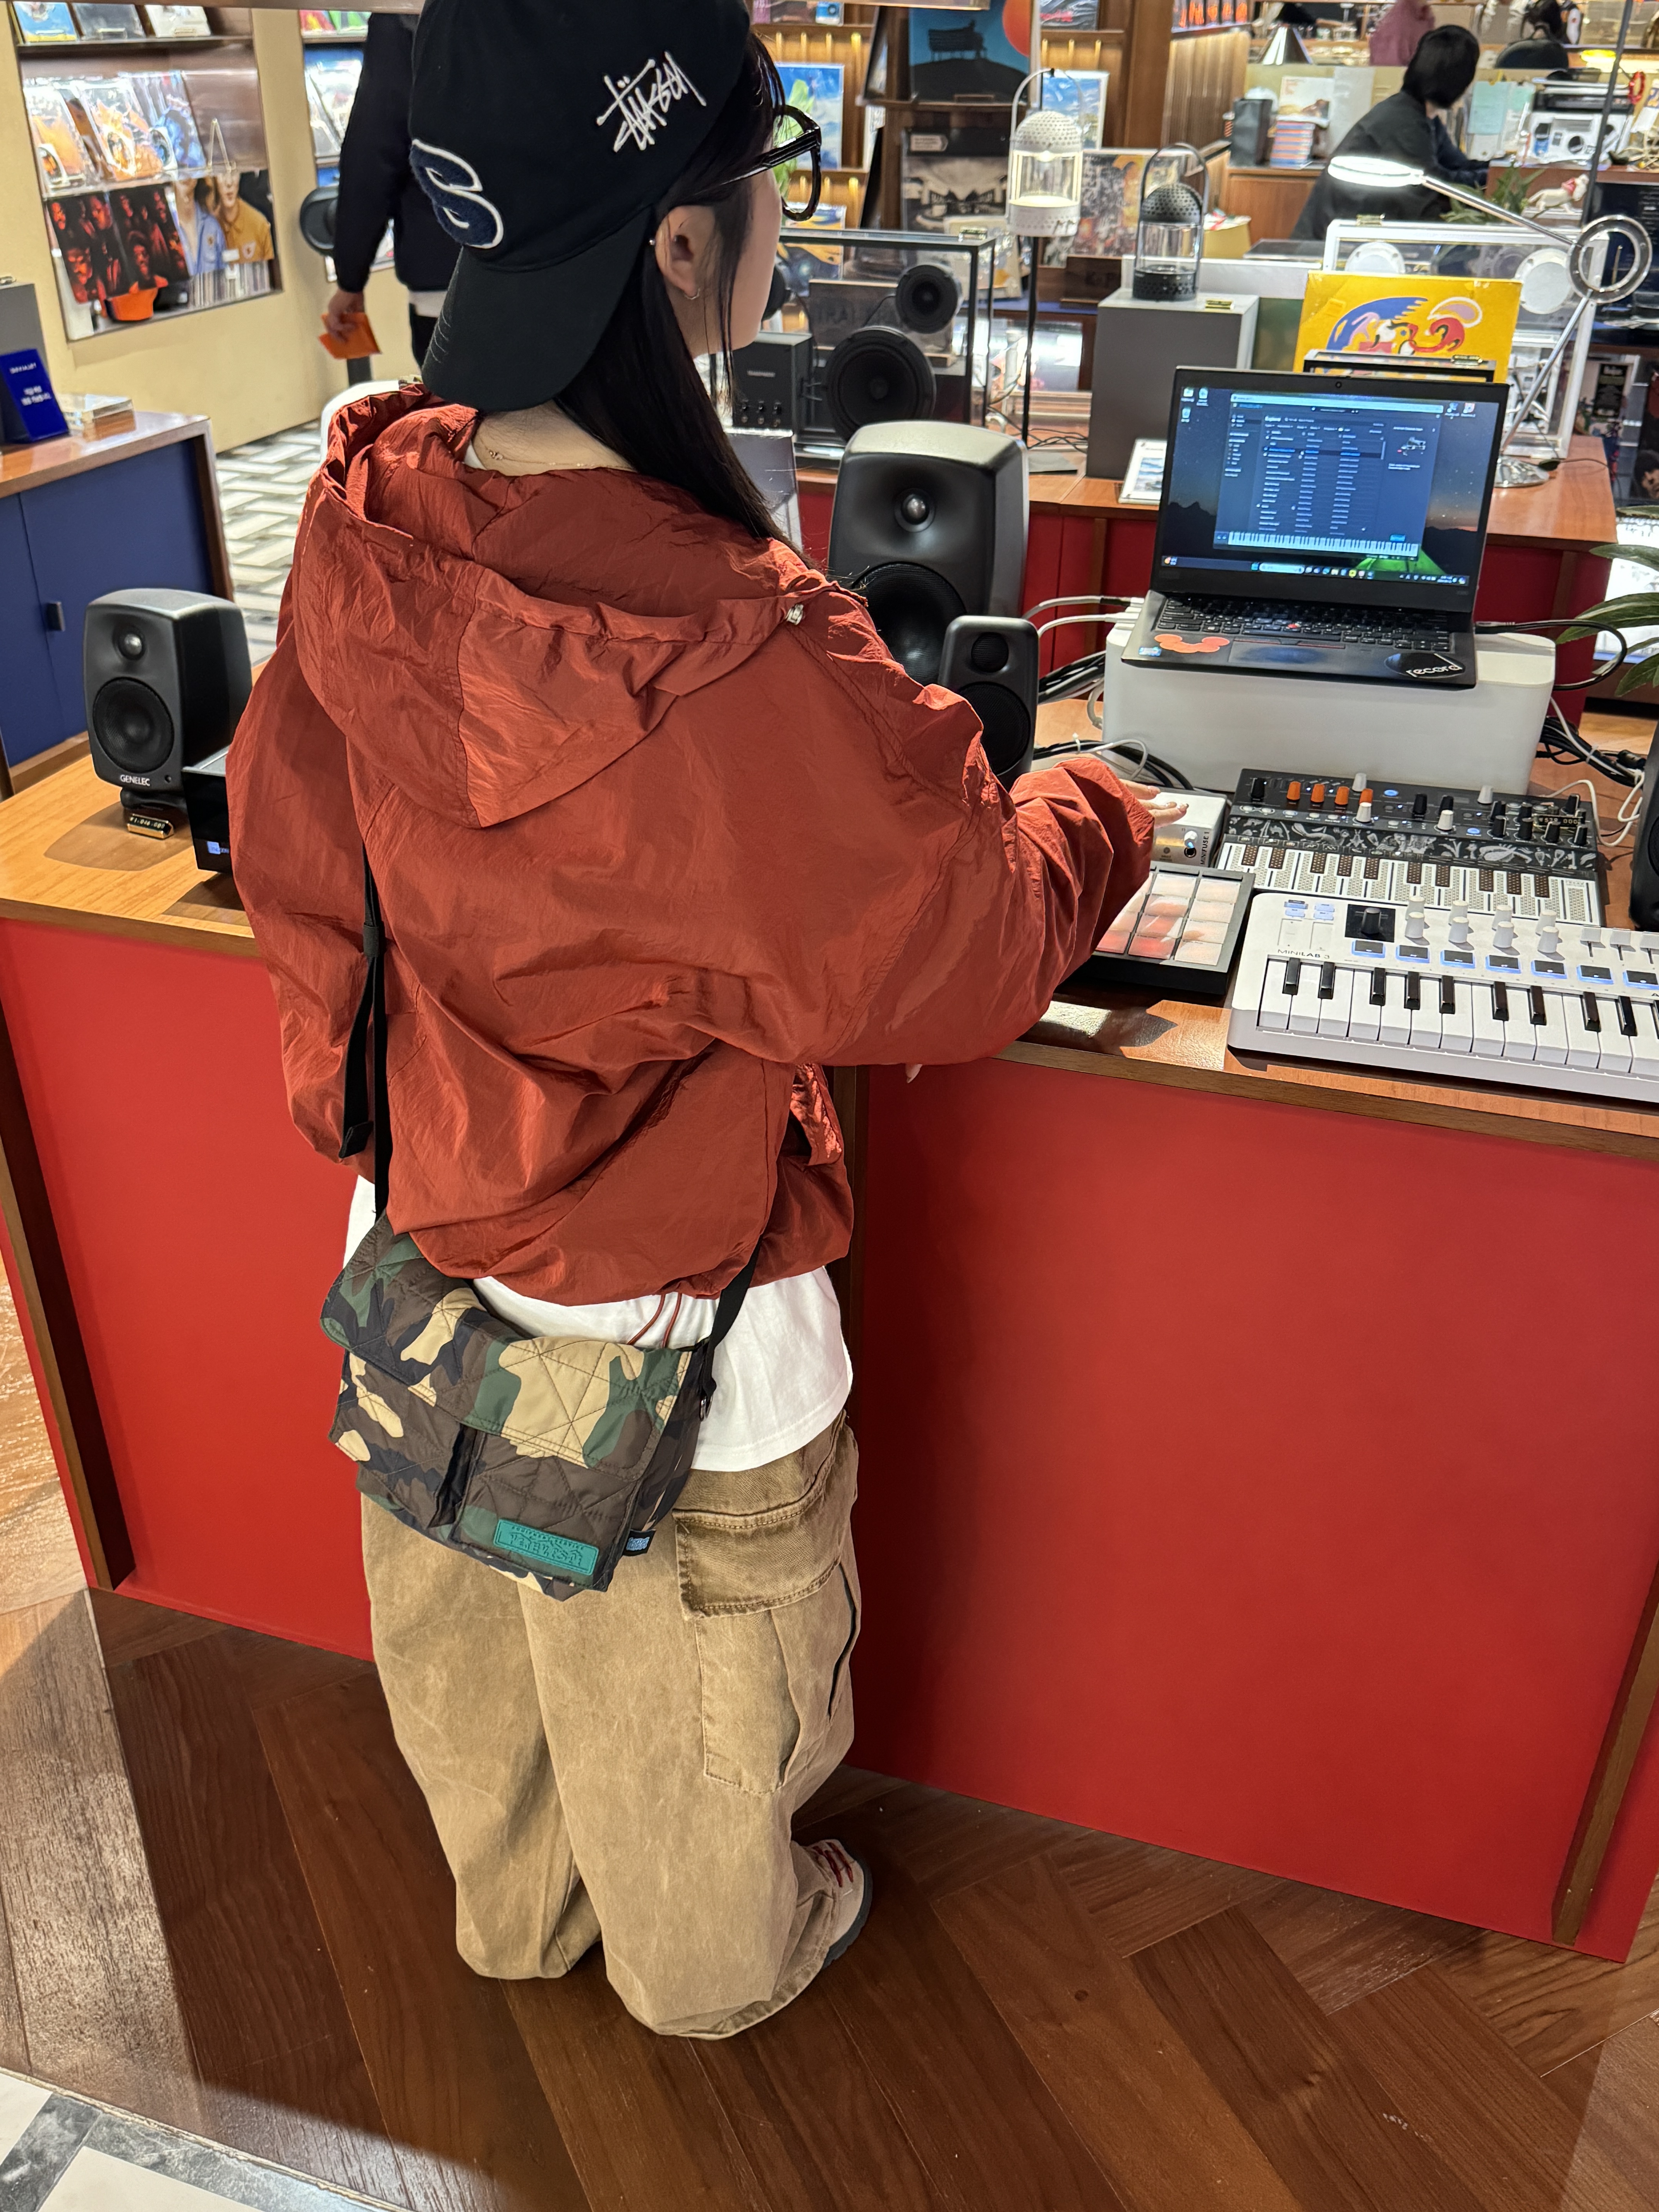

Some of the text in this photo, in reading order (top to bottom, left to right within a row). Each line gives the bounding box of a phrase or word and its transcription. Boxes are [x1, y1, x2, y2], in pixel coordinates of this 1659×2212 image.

[1406, 653, 1463, 677] record
[120, 774, 150, 786] GENELEC
[1278, 949, 1321, 958] MINILAB
[554, 1539, 585, 1551] SERVICE
